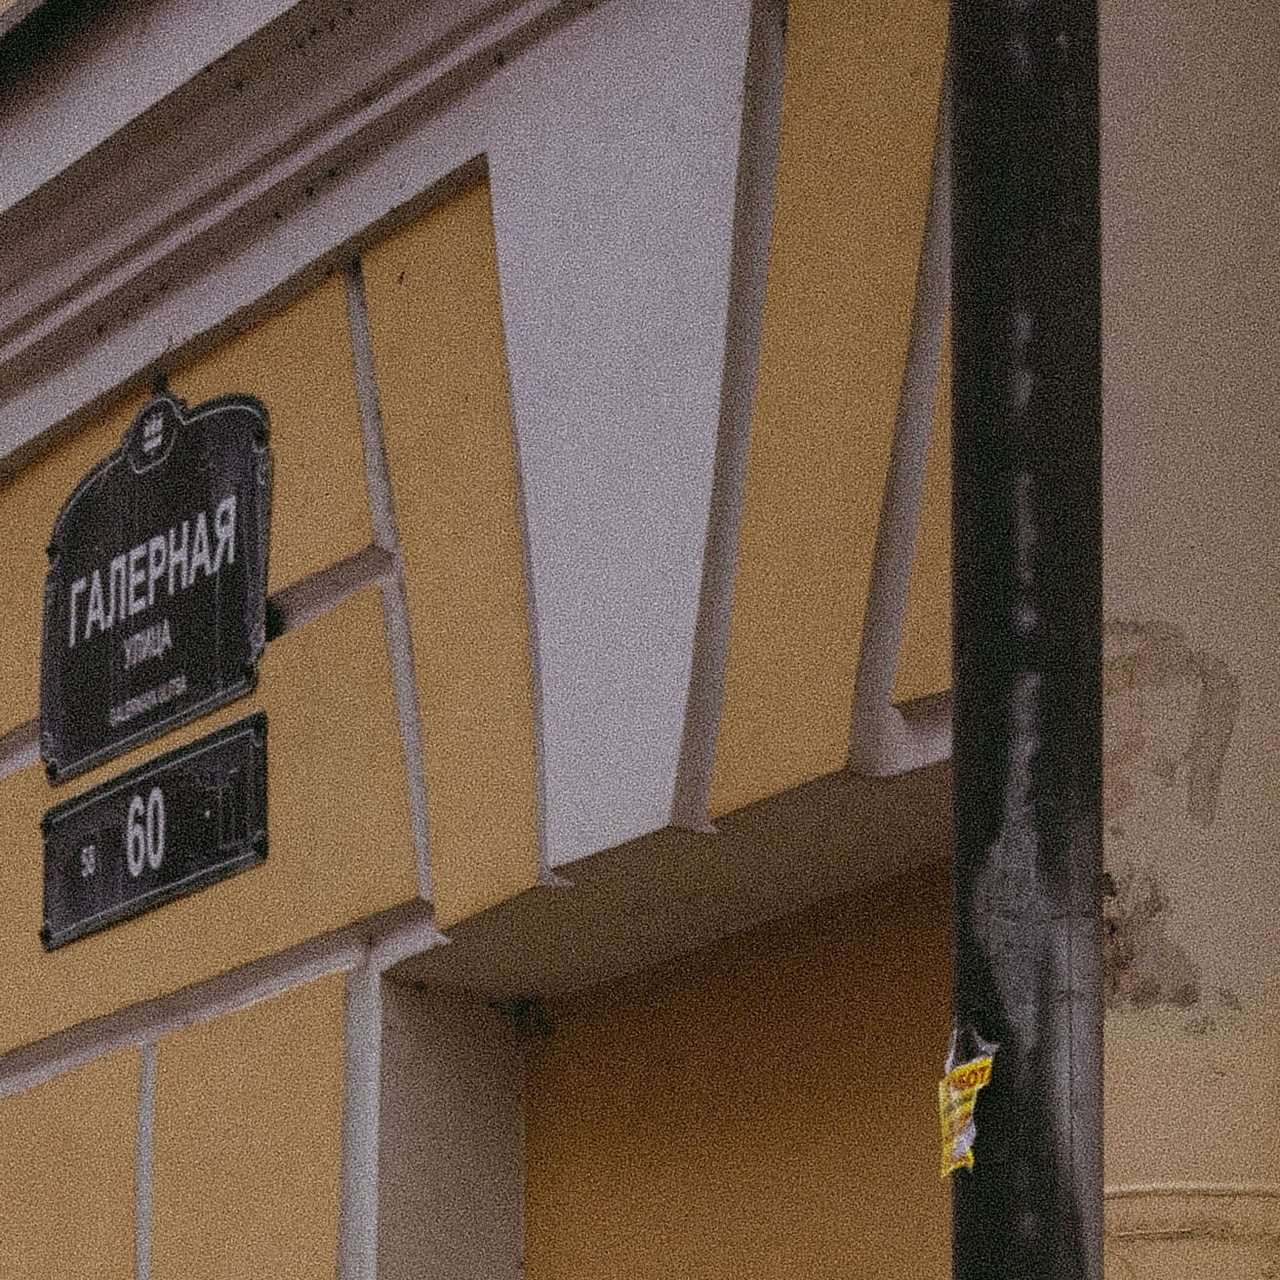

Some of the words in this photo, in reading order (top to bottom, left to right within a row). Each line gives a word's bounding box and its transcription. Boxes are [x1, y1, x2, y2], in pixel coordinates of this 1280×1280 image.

[68, 495, 237, 649] ГАЛЕРНАЯ
[123, 617, 173, 670] УЛИЦА
[126, 786, 165, 878] 60
